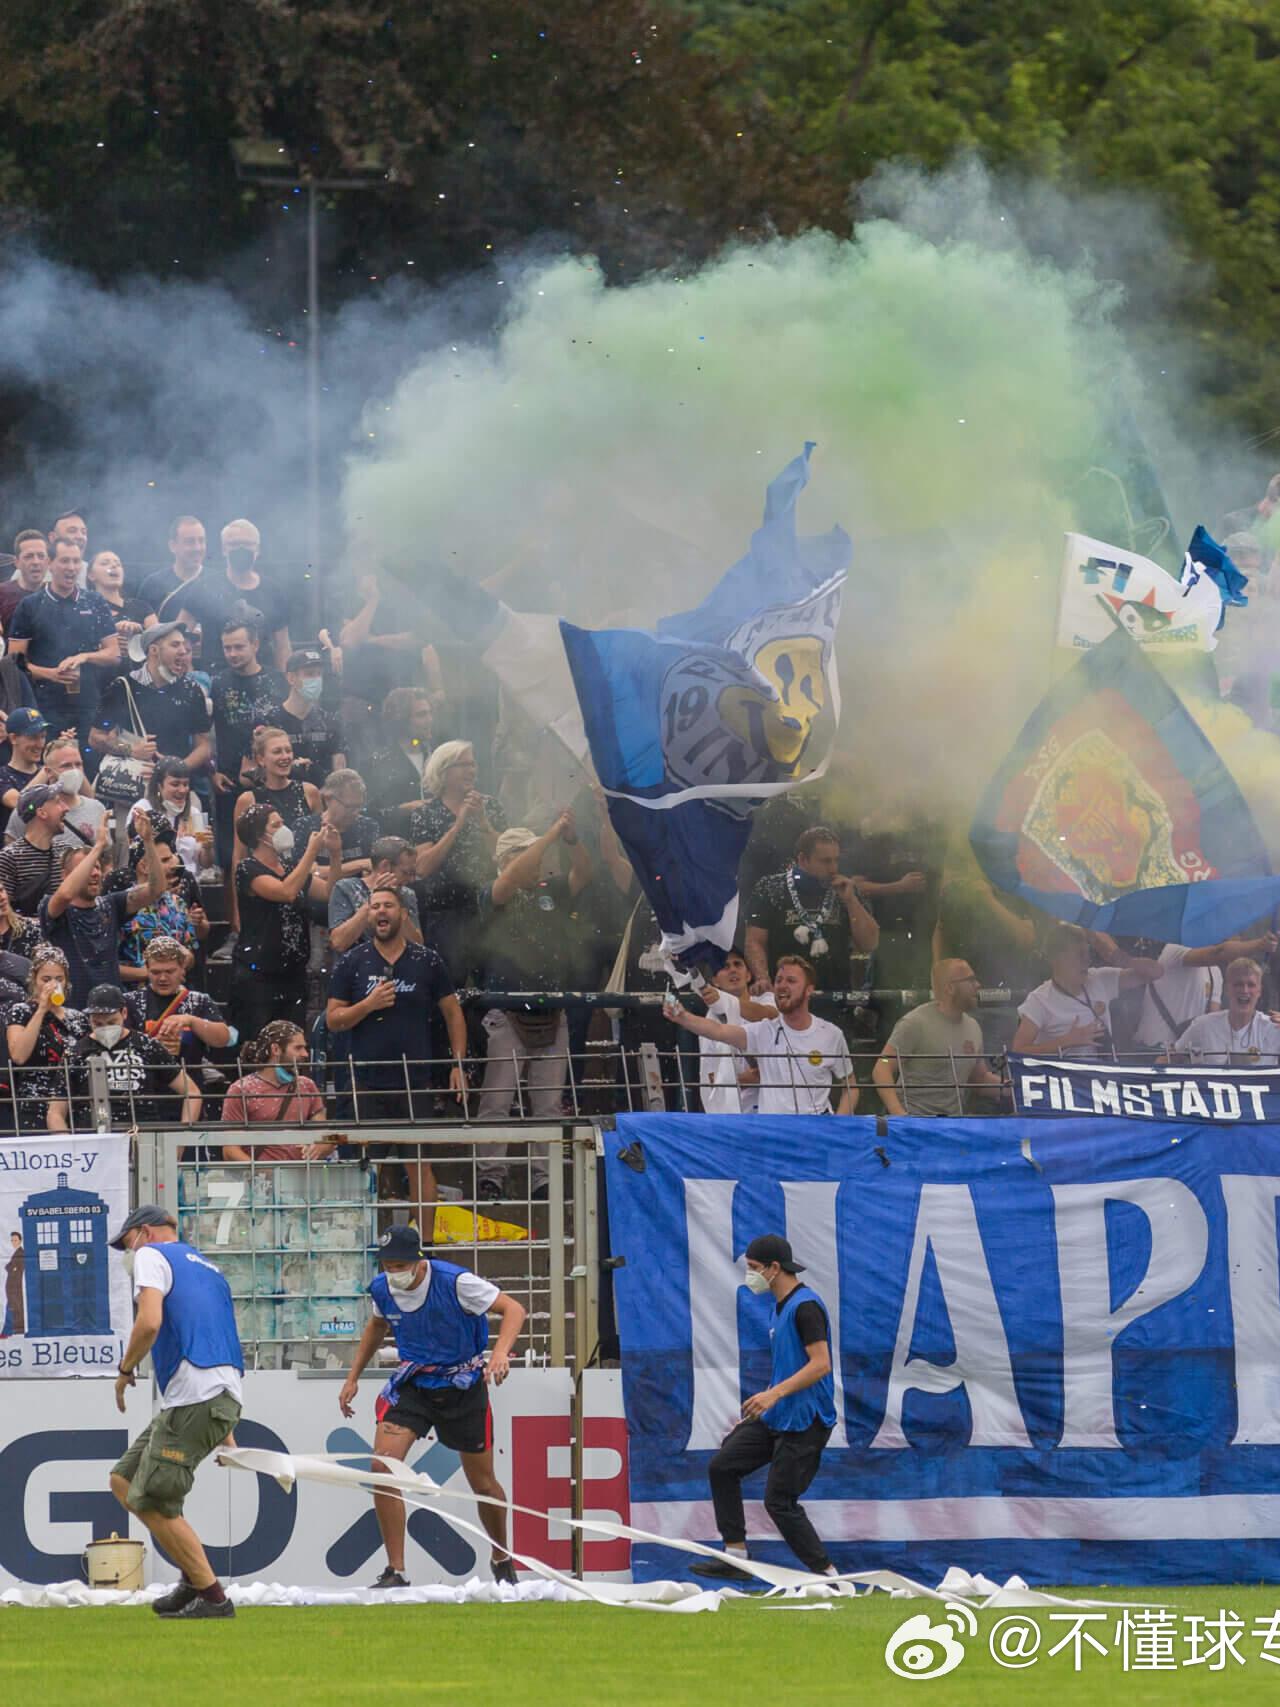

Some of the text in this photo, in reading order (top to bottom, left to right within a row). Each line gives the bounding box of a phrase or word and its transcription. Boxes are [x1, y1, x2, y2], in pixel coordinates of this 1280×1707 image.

[1021, 1075, 1269, 1120] FILMSTADT
[39, 1206, 90, 1216] BABELSBERG
[207, 1182, 244, 1245] 7
